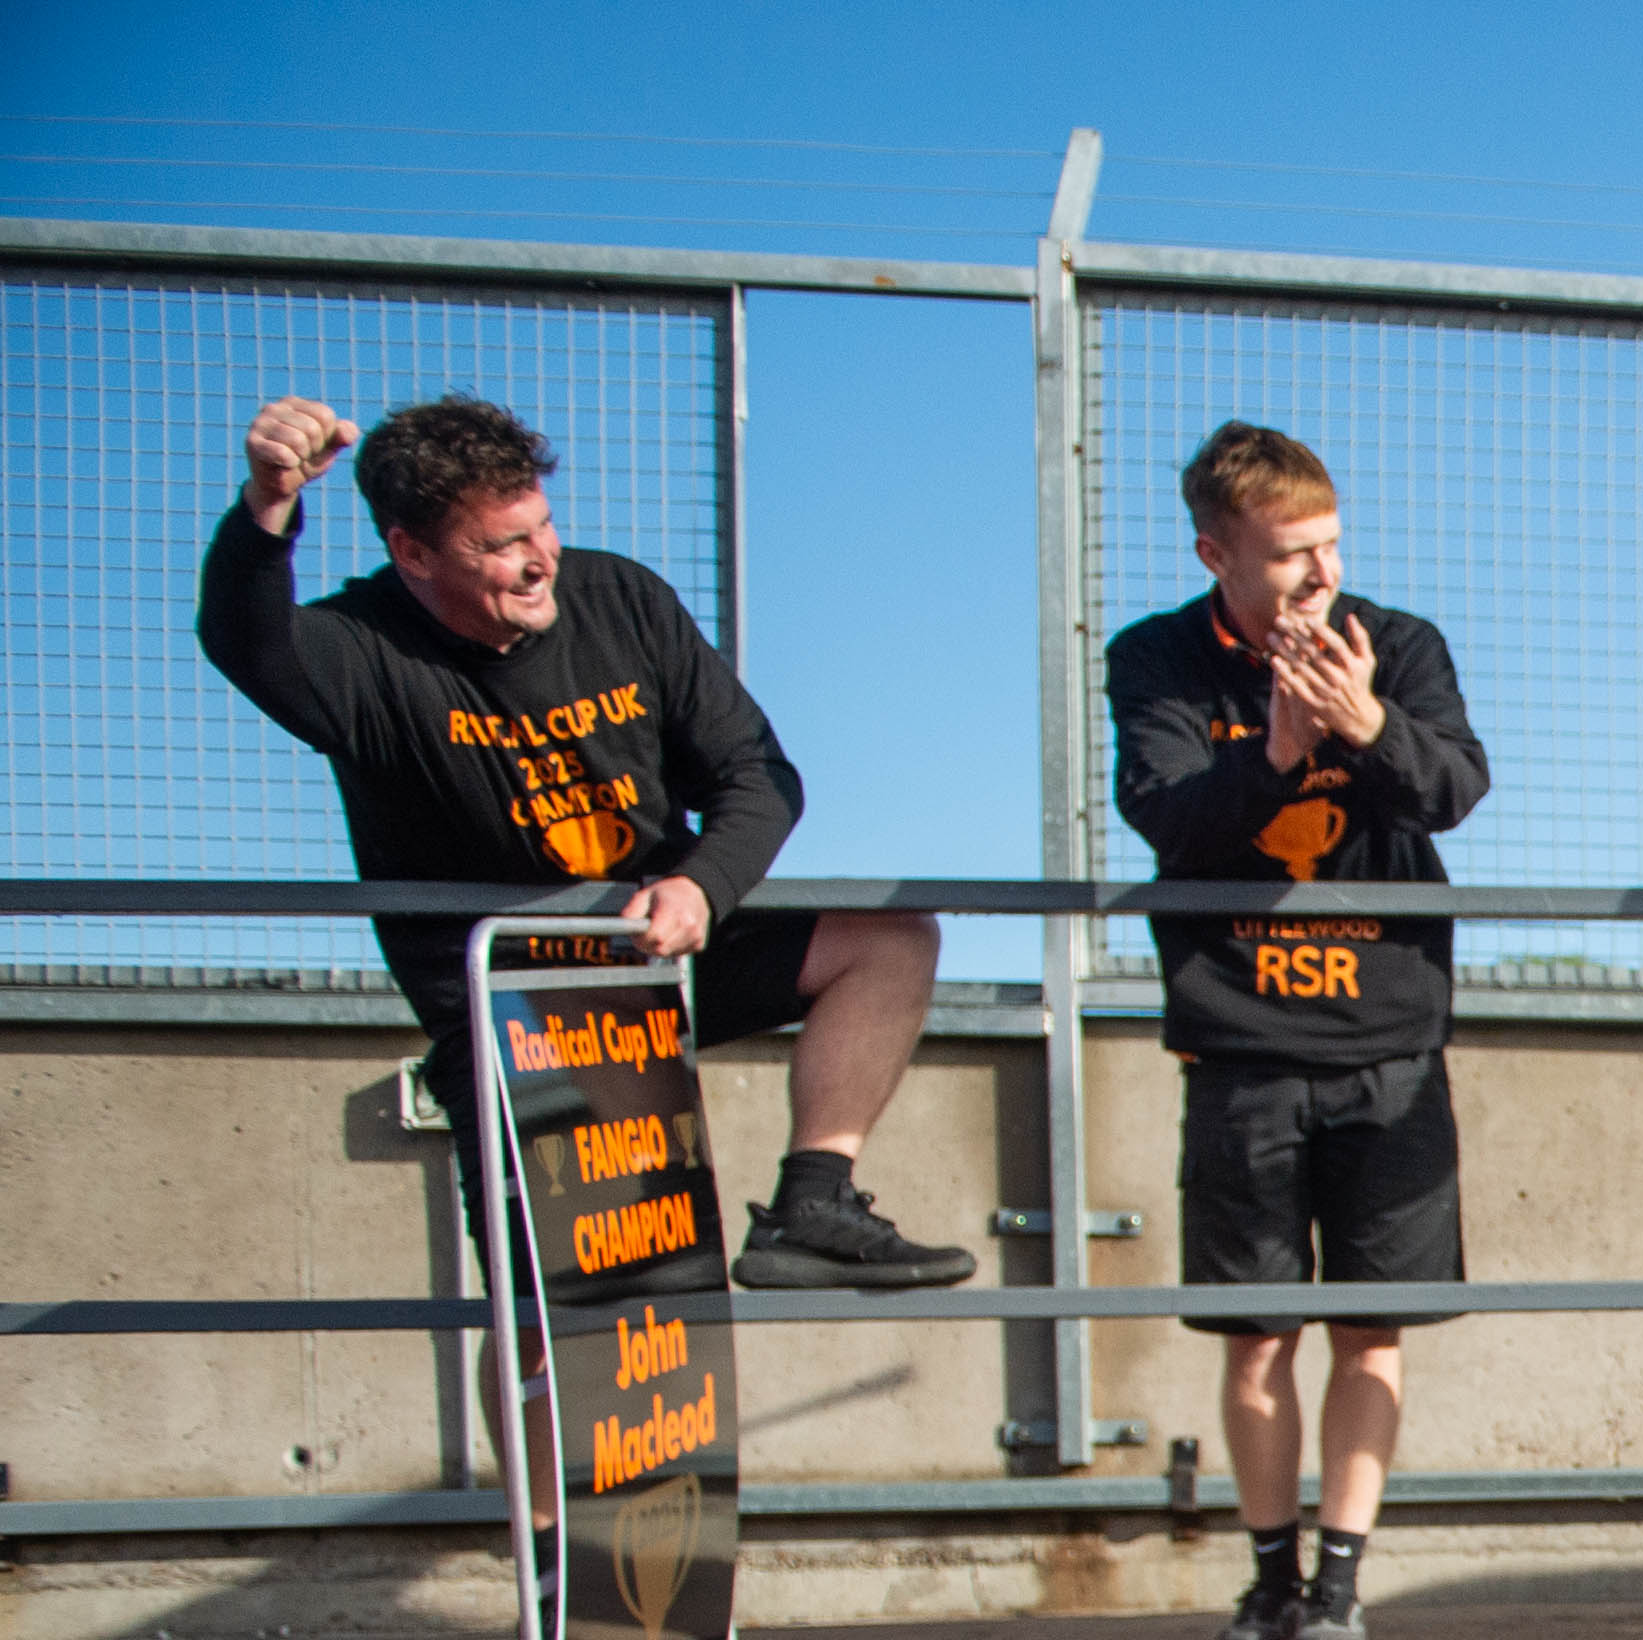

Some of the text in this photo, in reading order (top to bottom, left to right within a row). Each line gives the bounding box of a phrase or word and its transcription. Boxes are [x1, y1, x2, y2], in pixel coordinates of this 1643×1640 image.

[547, 699, 598, 740] CUP
[598, 682, 648, 725] UK
[511, 773, 639, 828] CHAMPON
[517, 750, 585, 791] 2025
[1256, 946, 1360, 999] RSR
[508, 1008, 684, 1073] Radical Cup UK
[576, 1113, 667, 1183] FANGIO
[574, 1191, 696, 1275] CHAMPION
[616, 1303, 686, 1389] John
[592, 1373, 716, 1493] Macleod
